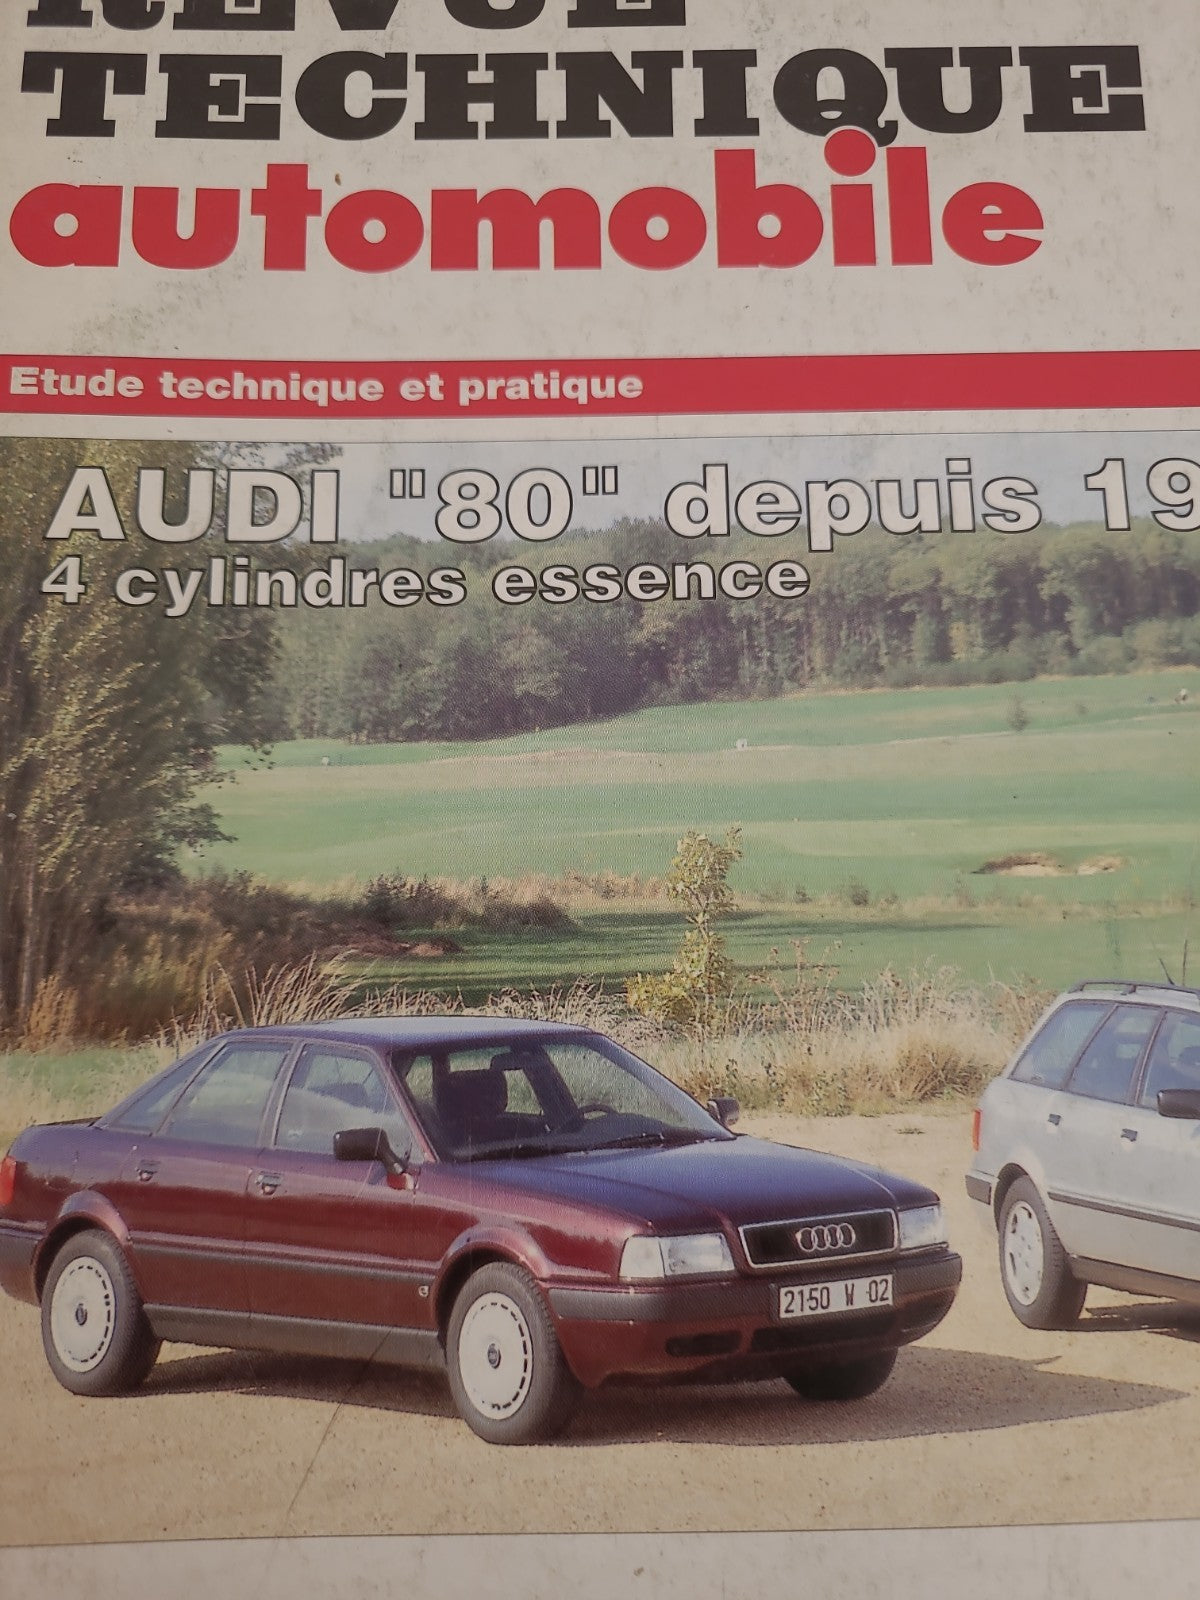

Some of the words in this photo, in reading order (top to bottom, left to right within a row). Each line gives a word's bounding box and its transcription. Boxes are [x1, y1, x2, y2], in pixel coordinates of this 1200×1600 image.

[20, 45, 1146, 147] TECHNIQUE
[9, 128, 1044, 273] automobile
[9, 366, 145, 398] Etude
[158, 371, 385, 407] technique
[400, 372, 445, 400] et
[458, 369, 644, 406] pratique
[44, 465, 340, 543] AUDI
[389, 465, 619, 543] "80"
[664, 456, 1042, 553] depuis
[1083, 457, 1200, 532] 19
[41, 555, 87, 605] 4
[114, 555, 467, 617] cylindres
[491, 559, 810, 605] essence
